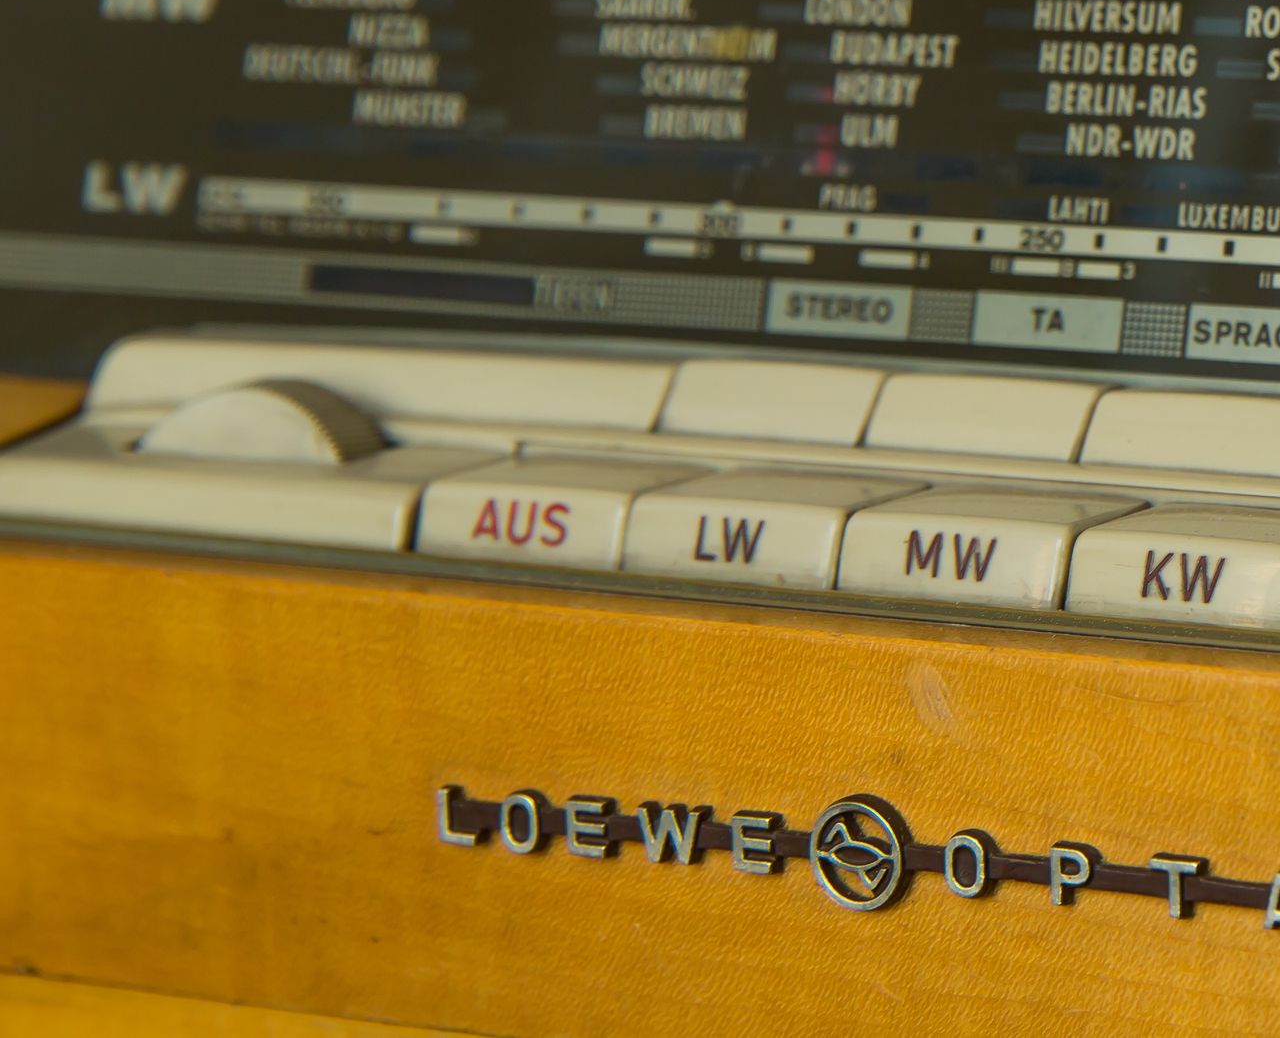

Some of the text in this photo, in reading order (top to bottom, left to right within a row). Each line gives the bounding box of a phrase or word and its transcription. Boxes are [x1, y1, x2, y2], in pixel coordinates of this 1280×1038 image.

[830, 30, 959, 68] BUDAPEST
[1038, 40, 1199, 77] HEIDELBERG
[1045, 81, 1207, 118] BERLIN-RIAS
[840, 112, 899, 148] ULM
[1065, 124, 1196, 161] NDR-WDR
[82, 160, 188, 215] LW
[819, 184, 876, 213] PRAG
[1048, 196, 1108, 226] LAHTI
[1020, 229, 1066, 252] 250
[787, 294, 893, 322] STEREO
[1030, 307, 1065, 334] TA
[472, 499, 570, 549] AUS
[692, 515, 767, 564] LW
[905, 529, 996, 582] MW
[1139, 549, 1226, 606] KW
[436, 783, 788, 877] LOEWE
